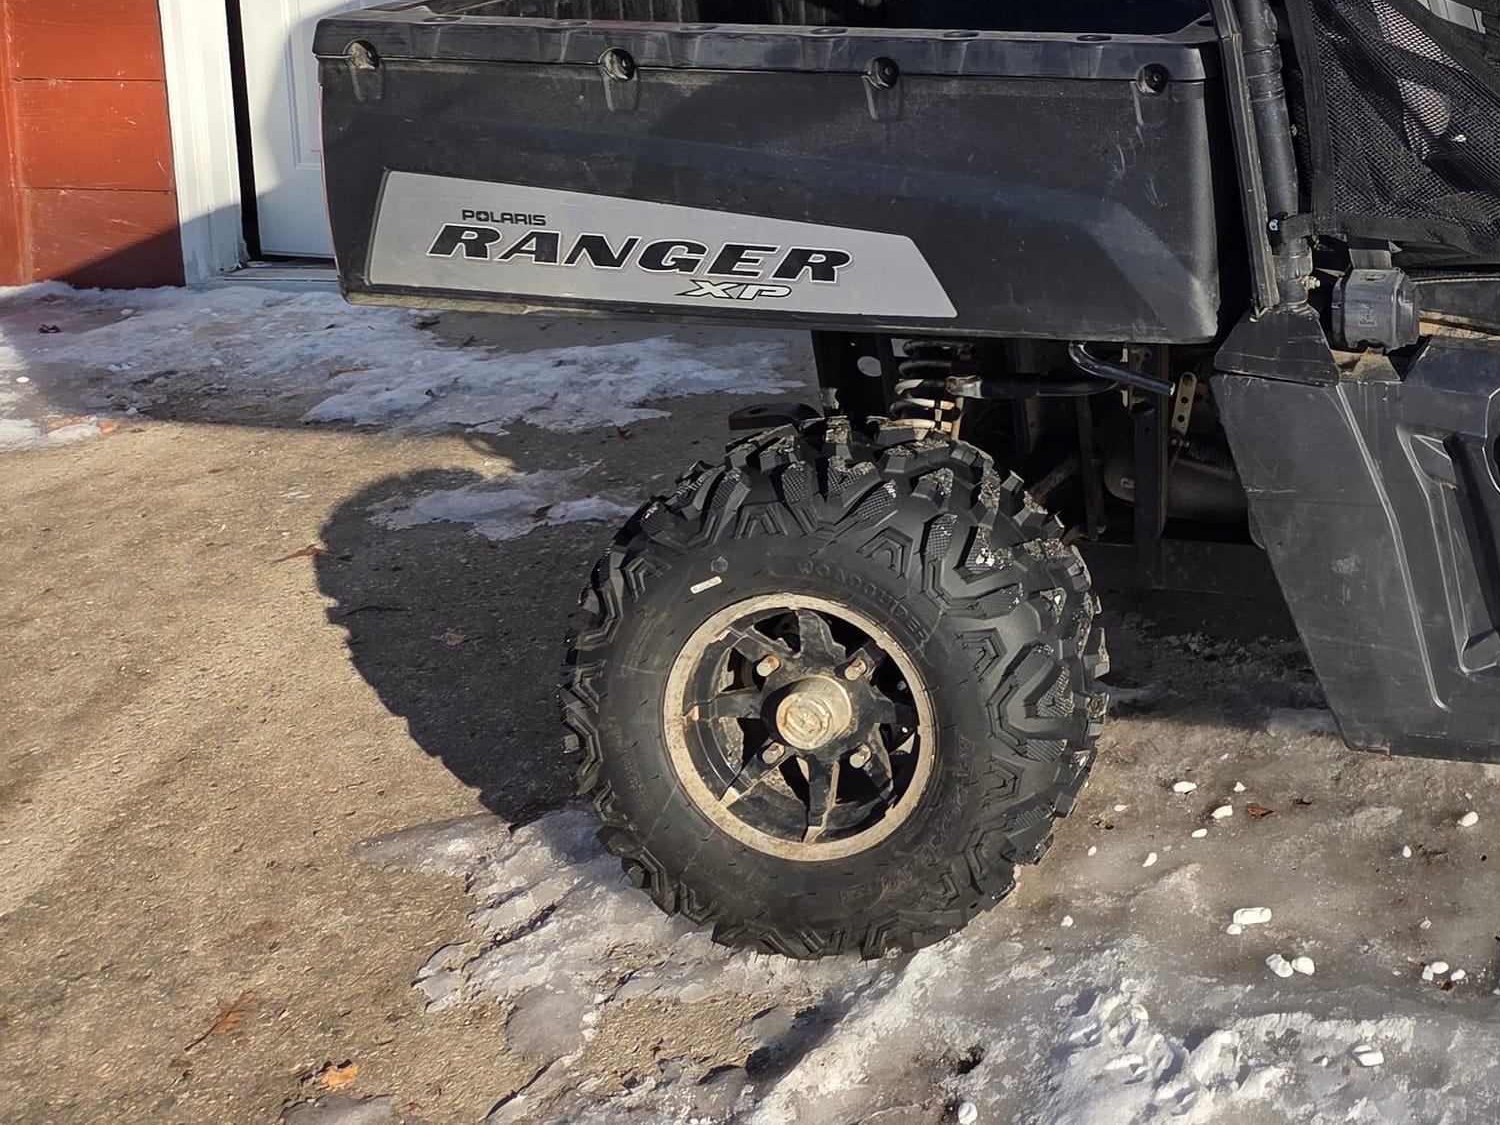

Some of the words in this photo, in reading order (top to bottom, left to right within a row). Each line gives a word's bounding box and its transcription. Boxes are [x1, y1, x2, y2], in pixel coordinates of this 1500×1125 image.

[461, 209, 547, 226] POLARIS
[426, 223, 853, 284] RANGER
[675, 279, 792, 300] XP
